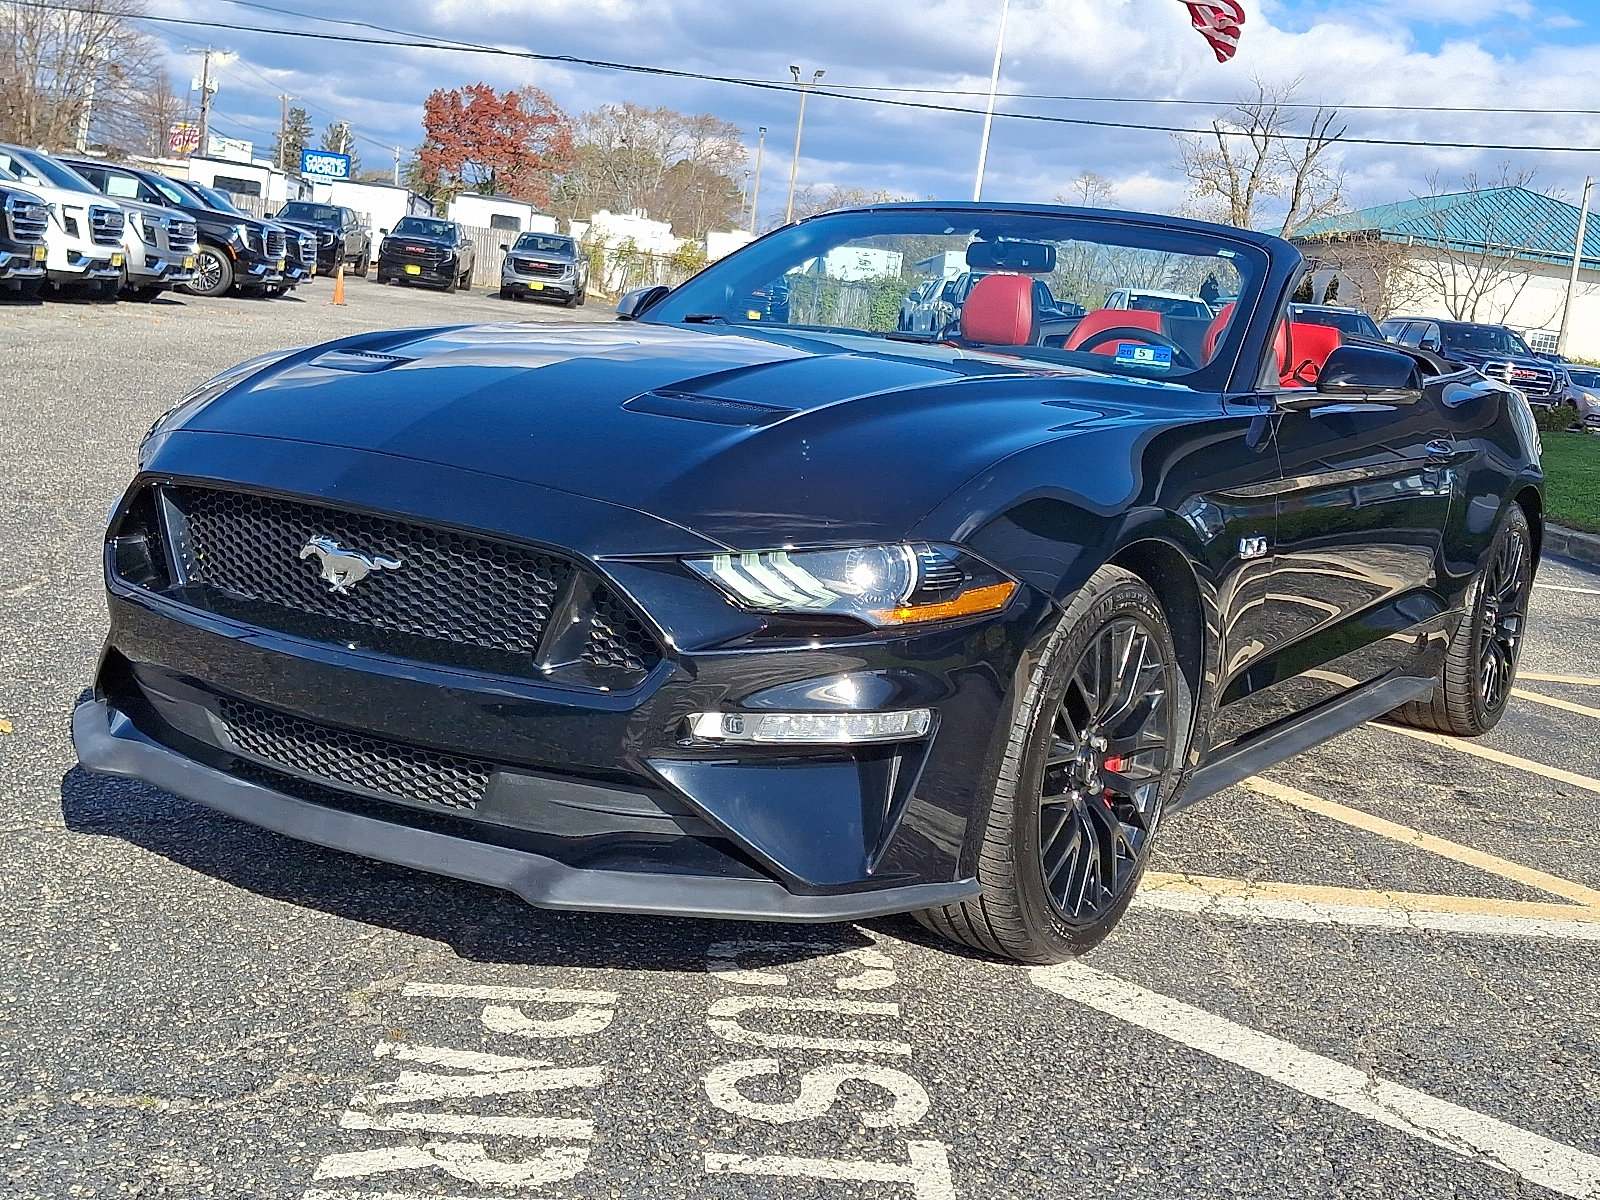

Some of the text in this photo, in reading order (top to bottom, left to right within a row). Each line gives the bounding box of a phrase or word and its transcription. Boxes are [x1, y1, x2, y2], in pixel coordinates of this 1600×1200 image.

[305, 154, 347, 168] CAMPING
[304, 161, 346, 177] WORLD
[1138, 349, 1146, 358] 5
[303, 981, 618, 1200] PAR
